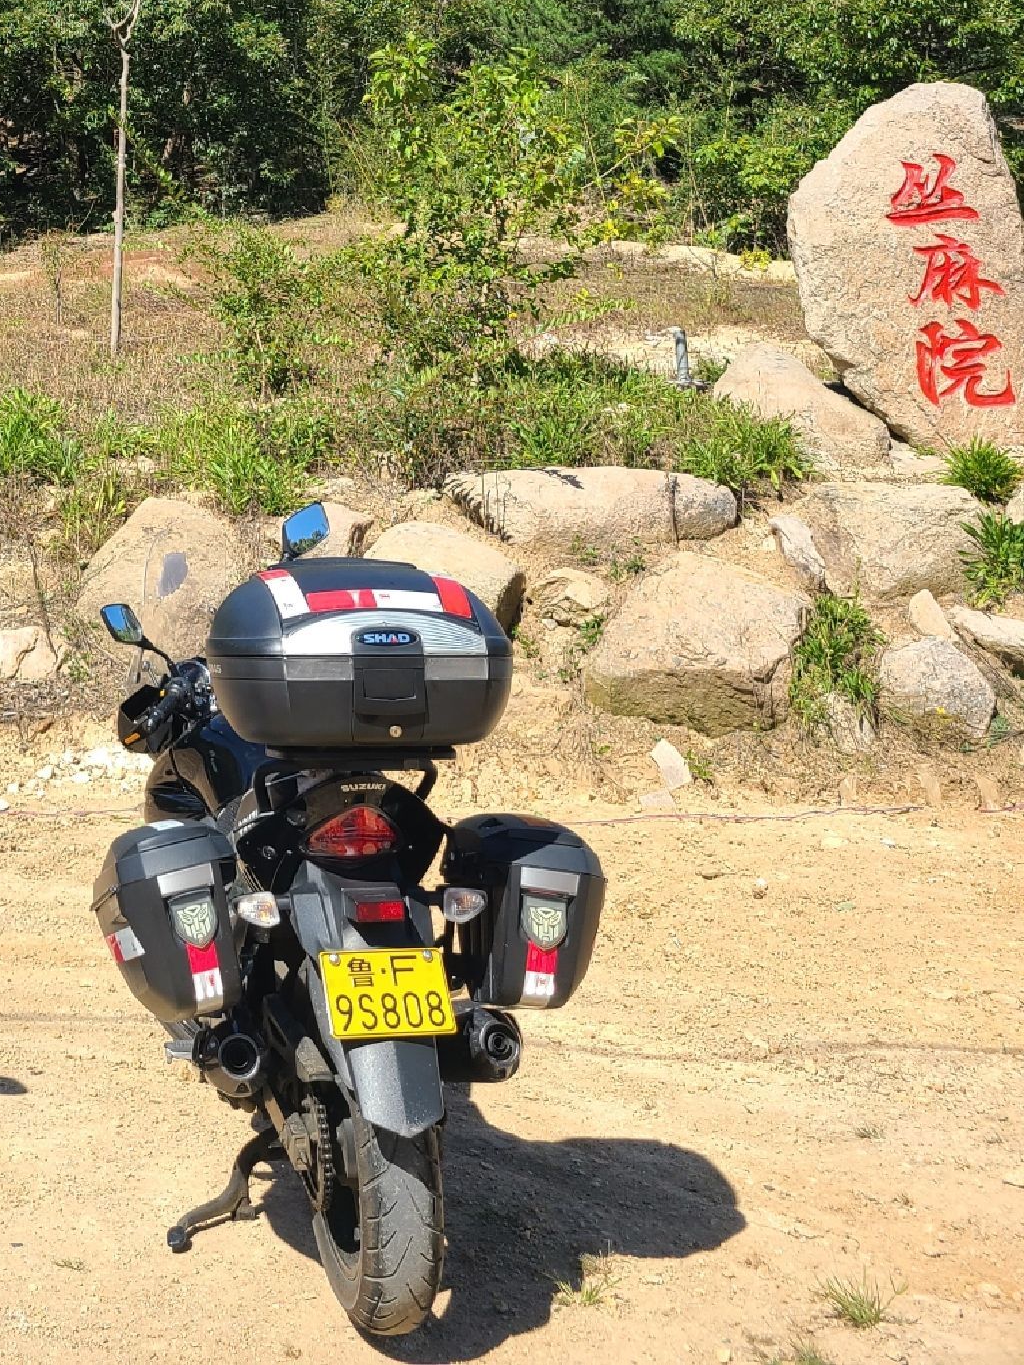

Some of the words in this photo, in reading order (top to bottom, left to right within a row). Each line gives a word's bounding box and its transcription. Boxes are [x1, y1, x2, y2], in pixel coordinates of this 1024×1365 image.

[885, 152, 1016, 408] 丛麻院
[363, 633, 411, 644] SHAD
[340, 783, 387, 793] SUZUKI
[335, 990, 447, 1032] 9S808
